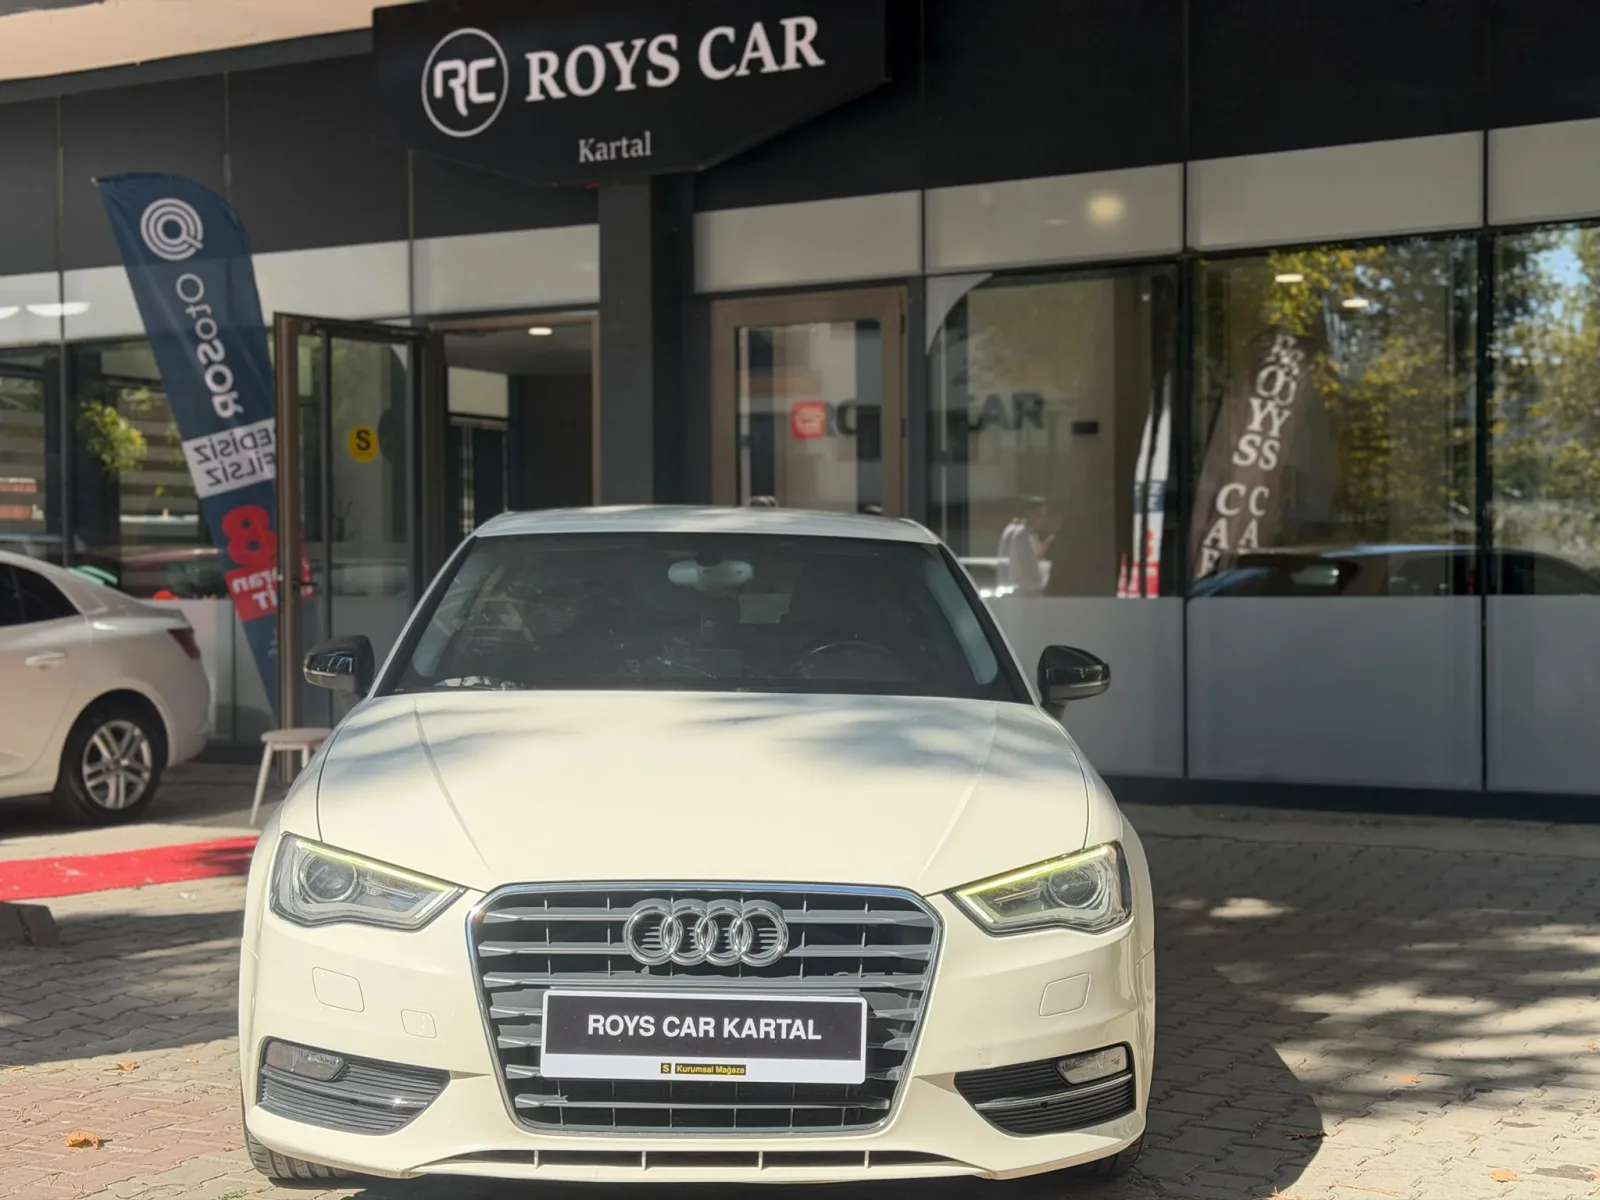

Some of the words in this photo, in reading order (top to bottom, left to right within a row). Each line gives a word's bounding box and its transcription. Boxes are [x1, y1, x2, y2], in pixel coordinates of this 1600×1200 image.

[524, 33, 681, 102] ROYS
[697, 15, 826, 80] CAR
[577, 130, 652, 164] Kartal
[355, 429, 372, 451] S
[587, 1014, 656, 1038] ROYS
[662, 1016, 716, 1039] CAR
[722, 1018, 823, 1041] KARTAL
[676, 1064, 714, 1073] Kurumsal
[715, 1066, 745, 1075] Mağaza
